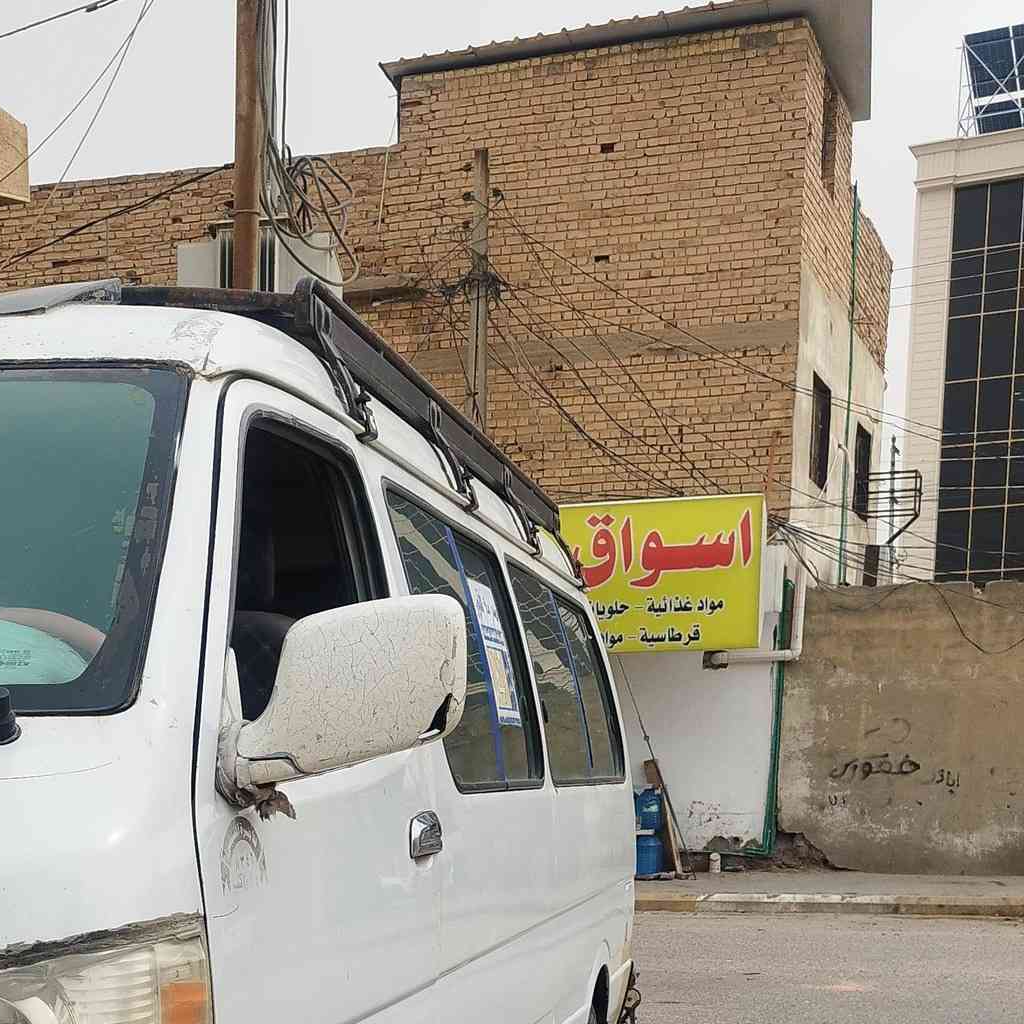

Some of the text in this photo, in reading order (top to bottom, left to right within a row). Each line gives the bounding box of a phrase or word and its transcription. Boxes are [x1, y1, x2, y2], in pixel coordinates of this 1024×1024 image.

[572, 508, 753, 588] اسواق
[646, 596, 693, 616] غذائية
[696, 596, 724, 616] مواد
[640, 624, 701, 646] قرطاسية
